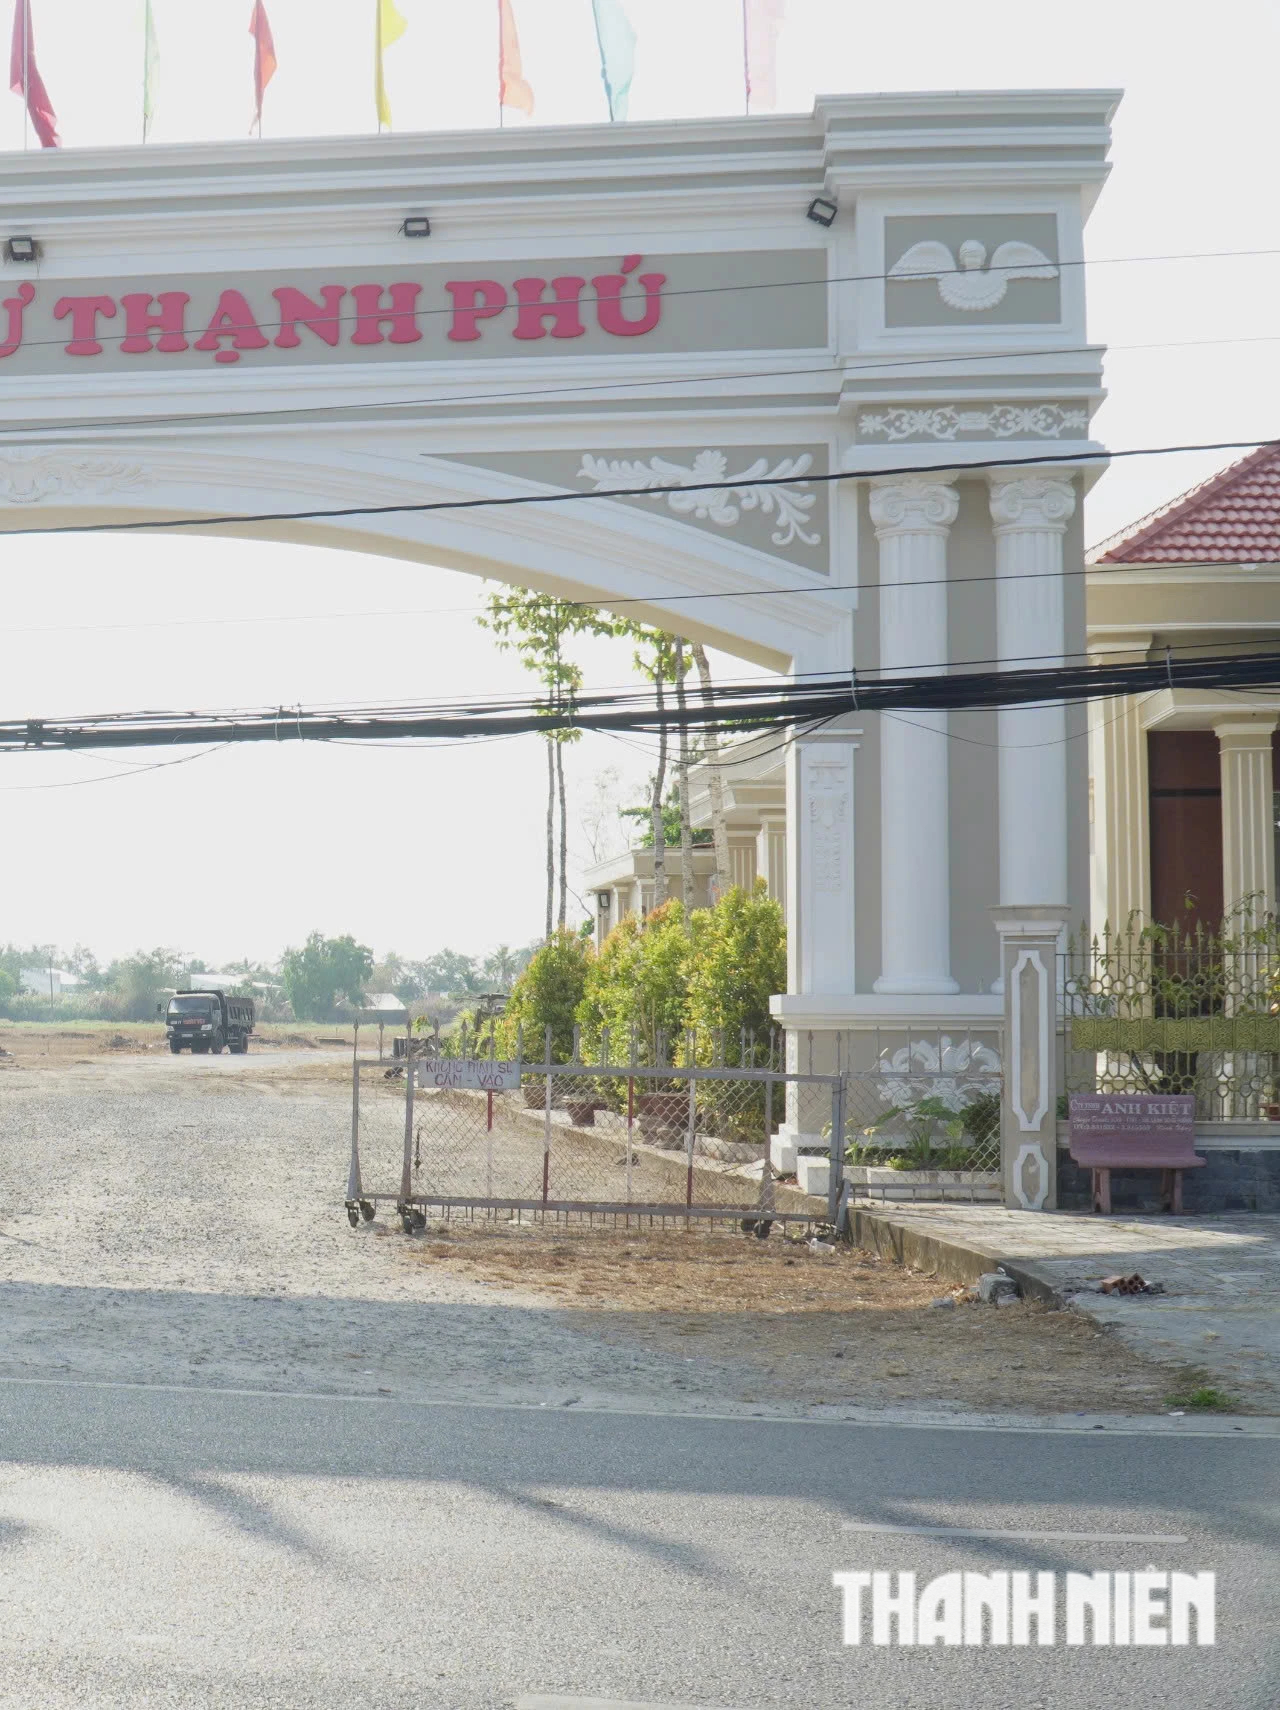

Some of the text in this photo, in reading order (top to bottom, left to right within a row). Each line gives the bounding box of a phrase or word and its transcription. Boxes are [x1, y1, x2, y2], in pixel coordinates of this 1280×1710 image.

[53, 282, 423, 363] THẠNH
[445, 254, 667, 341] PHÚ
[1101, 1103, 1141, 1115] ANH
